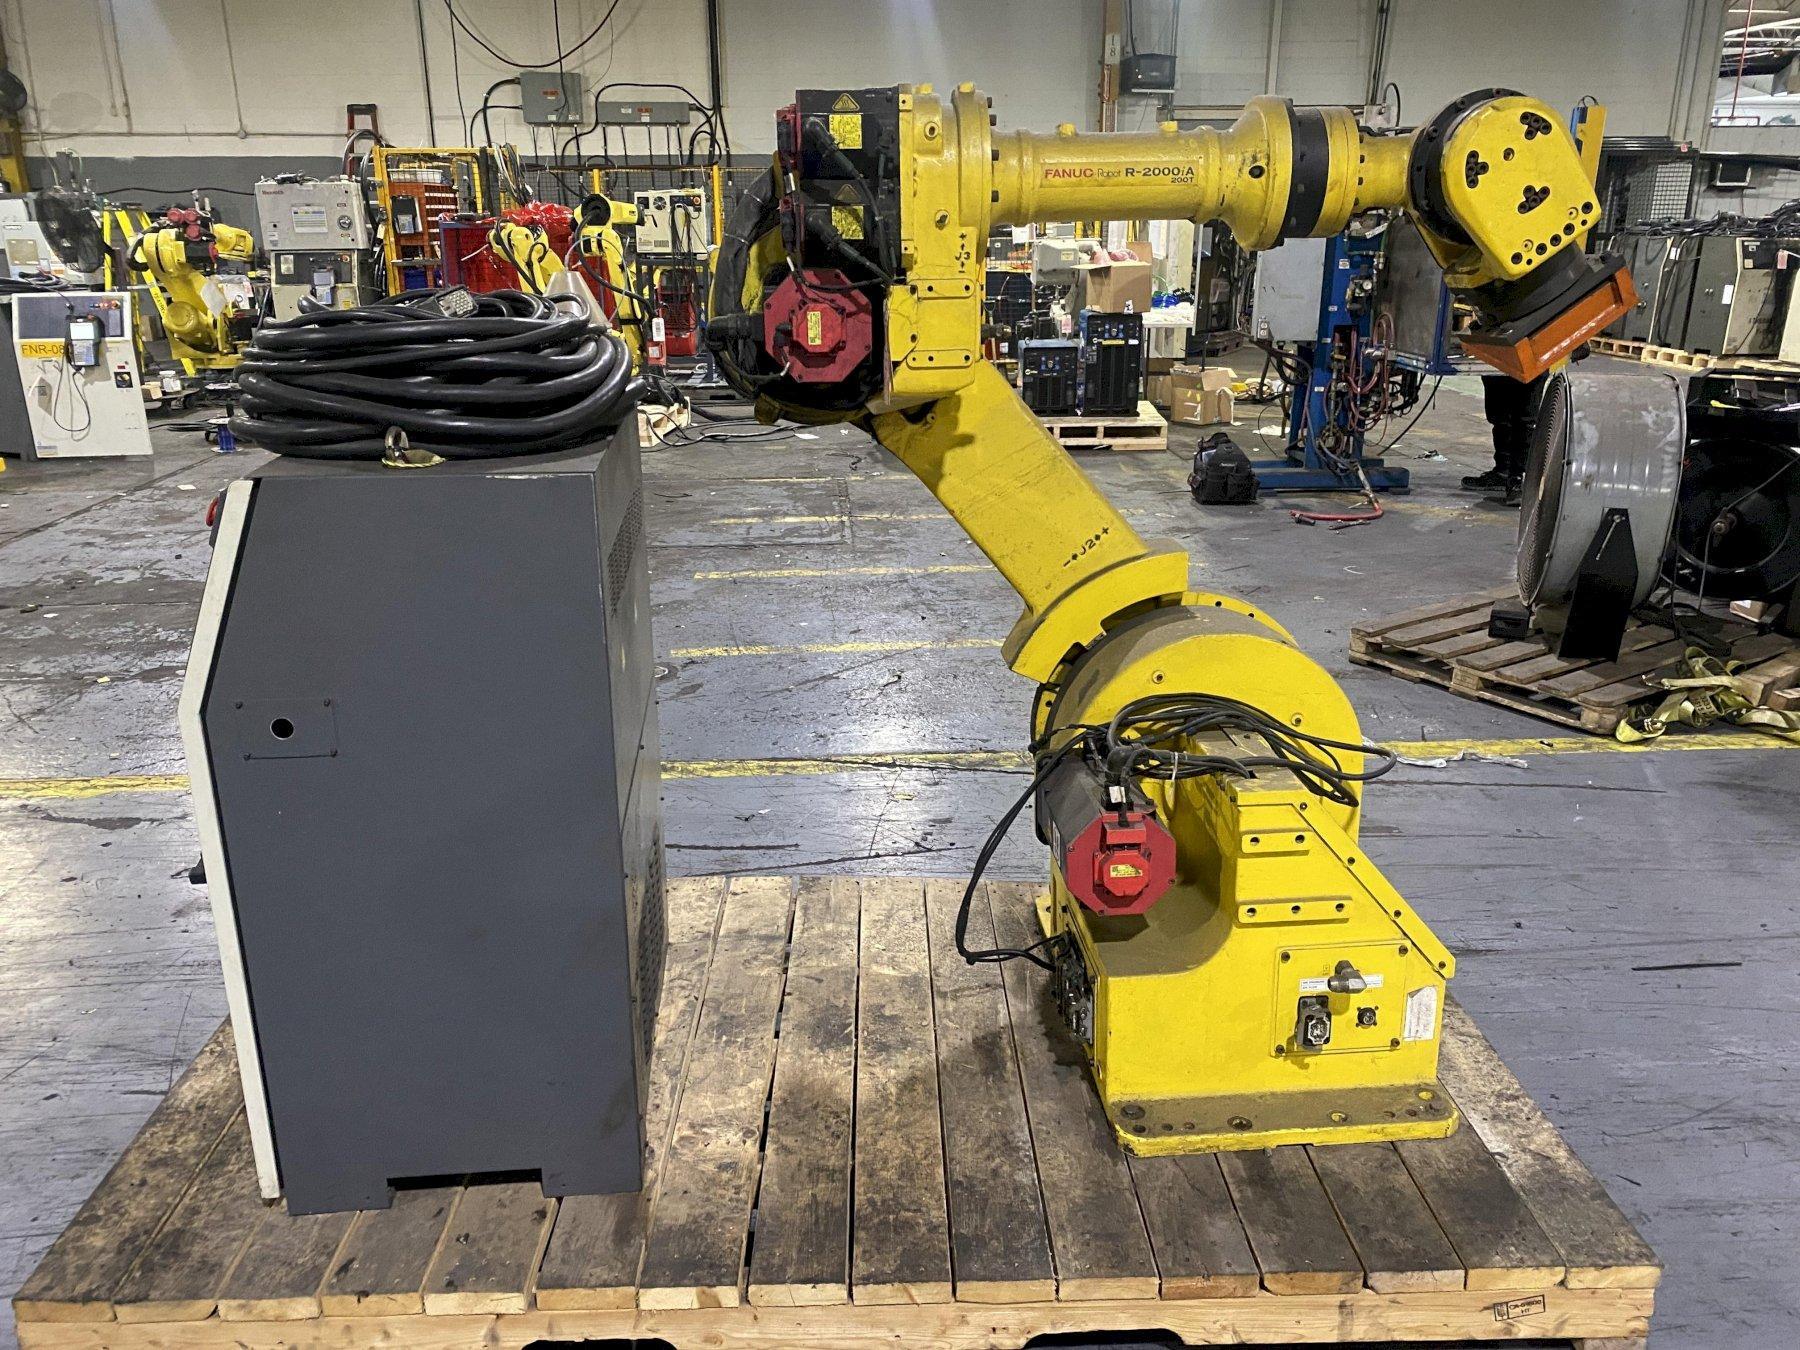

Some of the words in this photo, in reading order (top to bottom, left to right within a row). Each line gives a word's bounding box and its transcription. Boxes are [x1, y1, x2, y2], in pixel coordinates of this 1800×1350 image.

[1044, 168, 1094, 179] FANUC
[1097, 168, 1121, 179] Robot
[1125, 166, 1195, 177] R-2000iA
[1170, 176, 1195, 184] 200T
